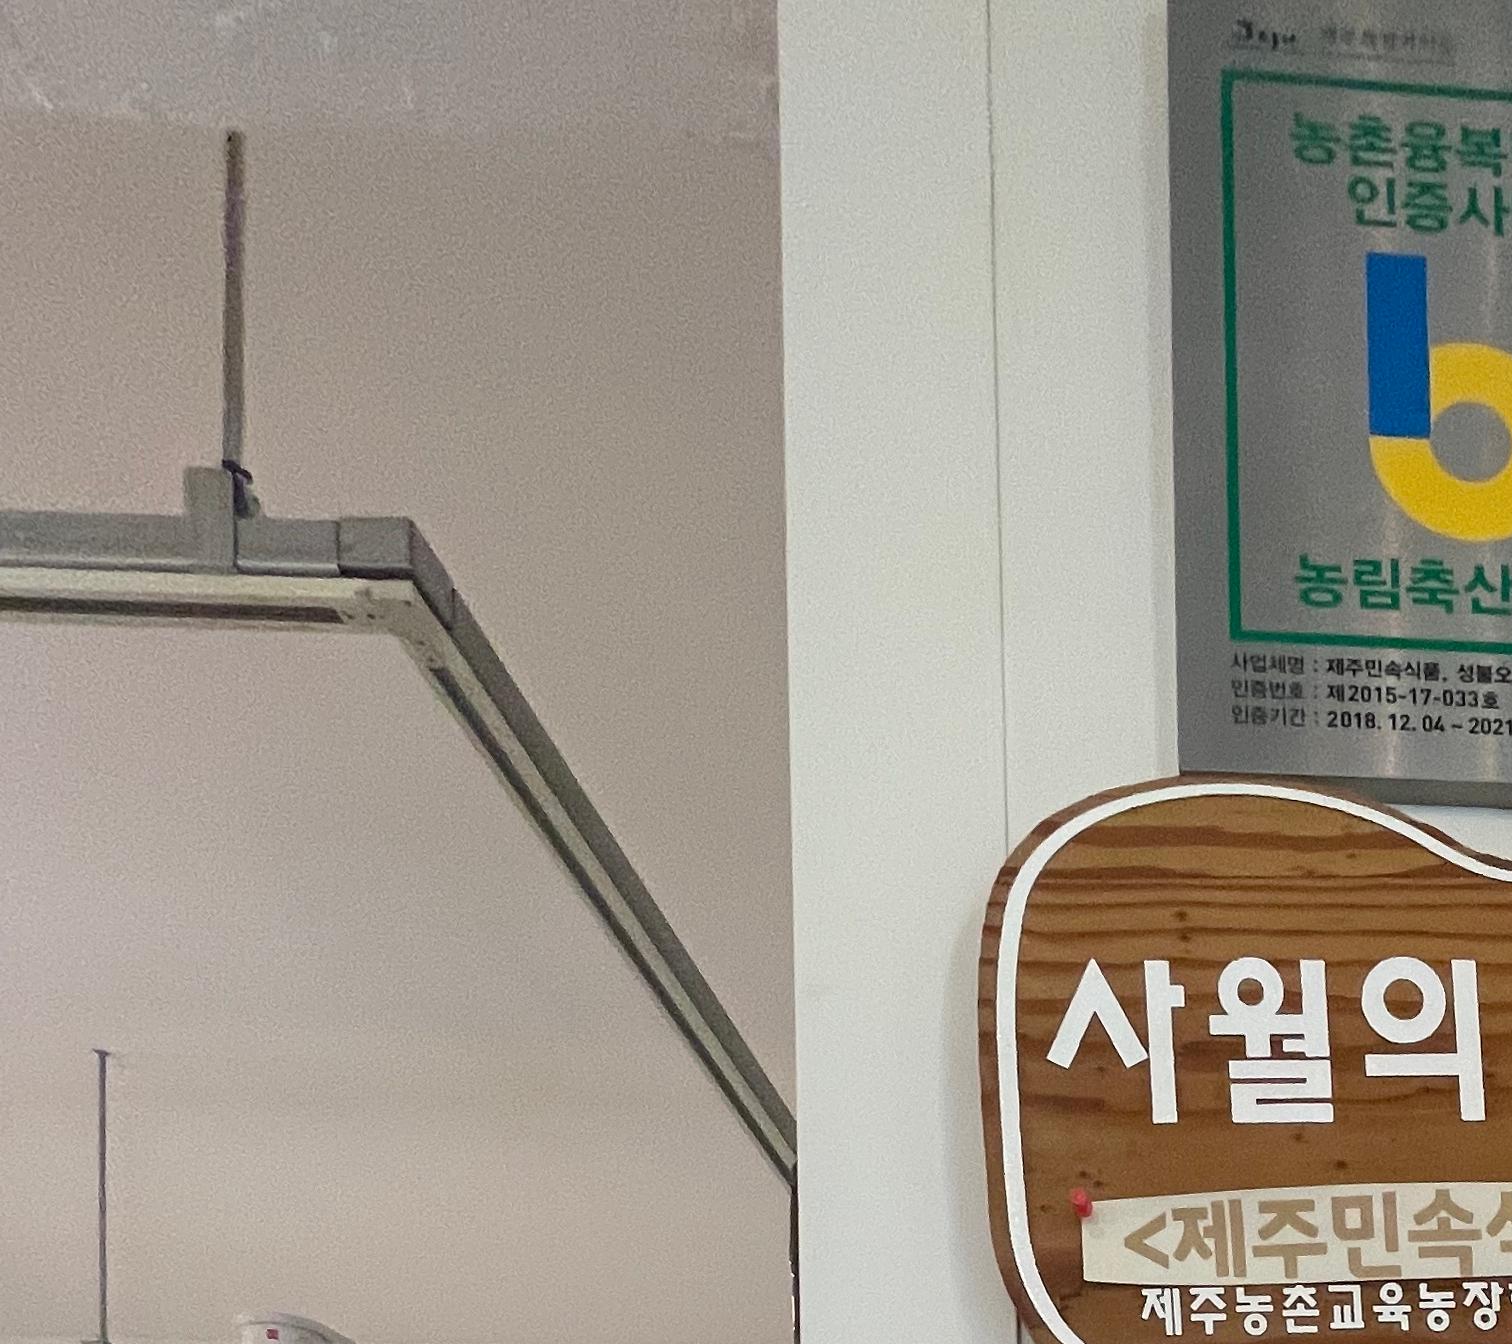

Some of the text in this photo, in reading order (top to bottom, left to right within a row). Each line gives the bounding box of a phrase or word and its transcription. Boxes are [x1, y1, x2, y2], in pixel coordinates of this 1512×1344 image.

[1231, 678, 1499, 710] 인증번호 제2015-17-033호
[1231, 705, 1306, 728] 인증기간
[1046, 955, 1486, 1125] 사월의
